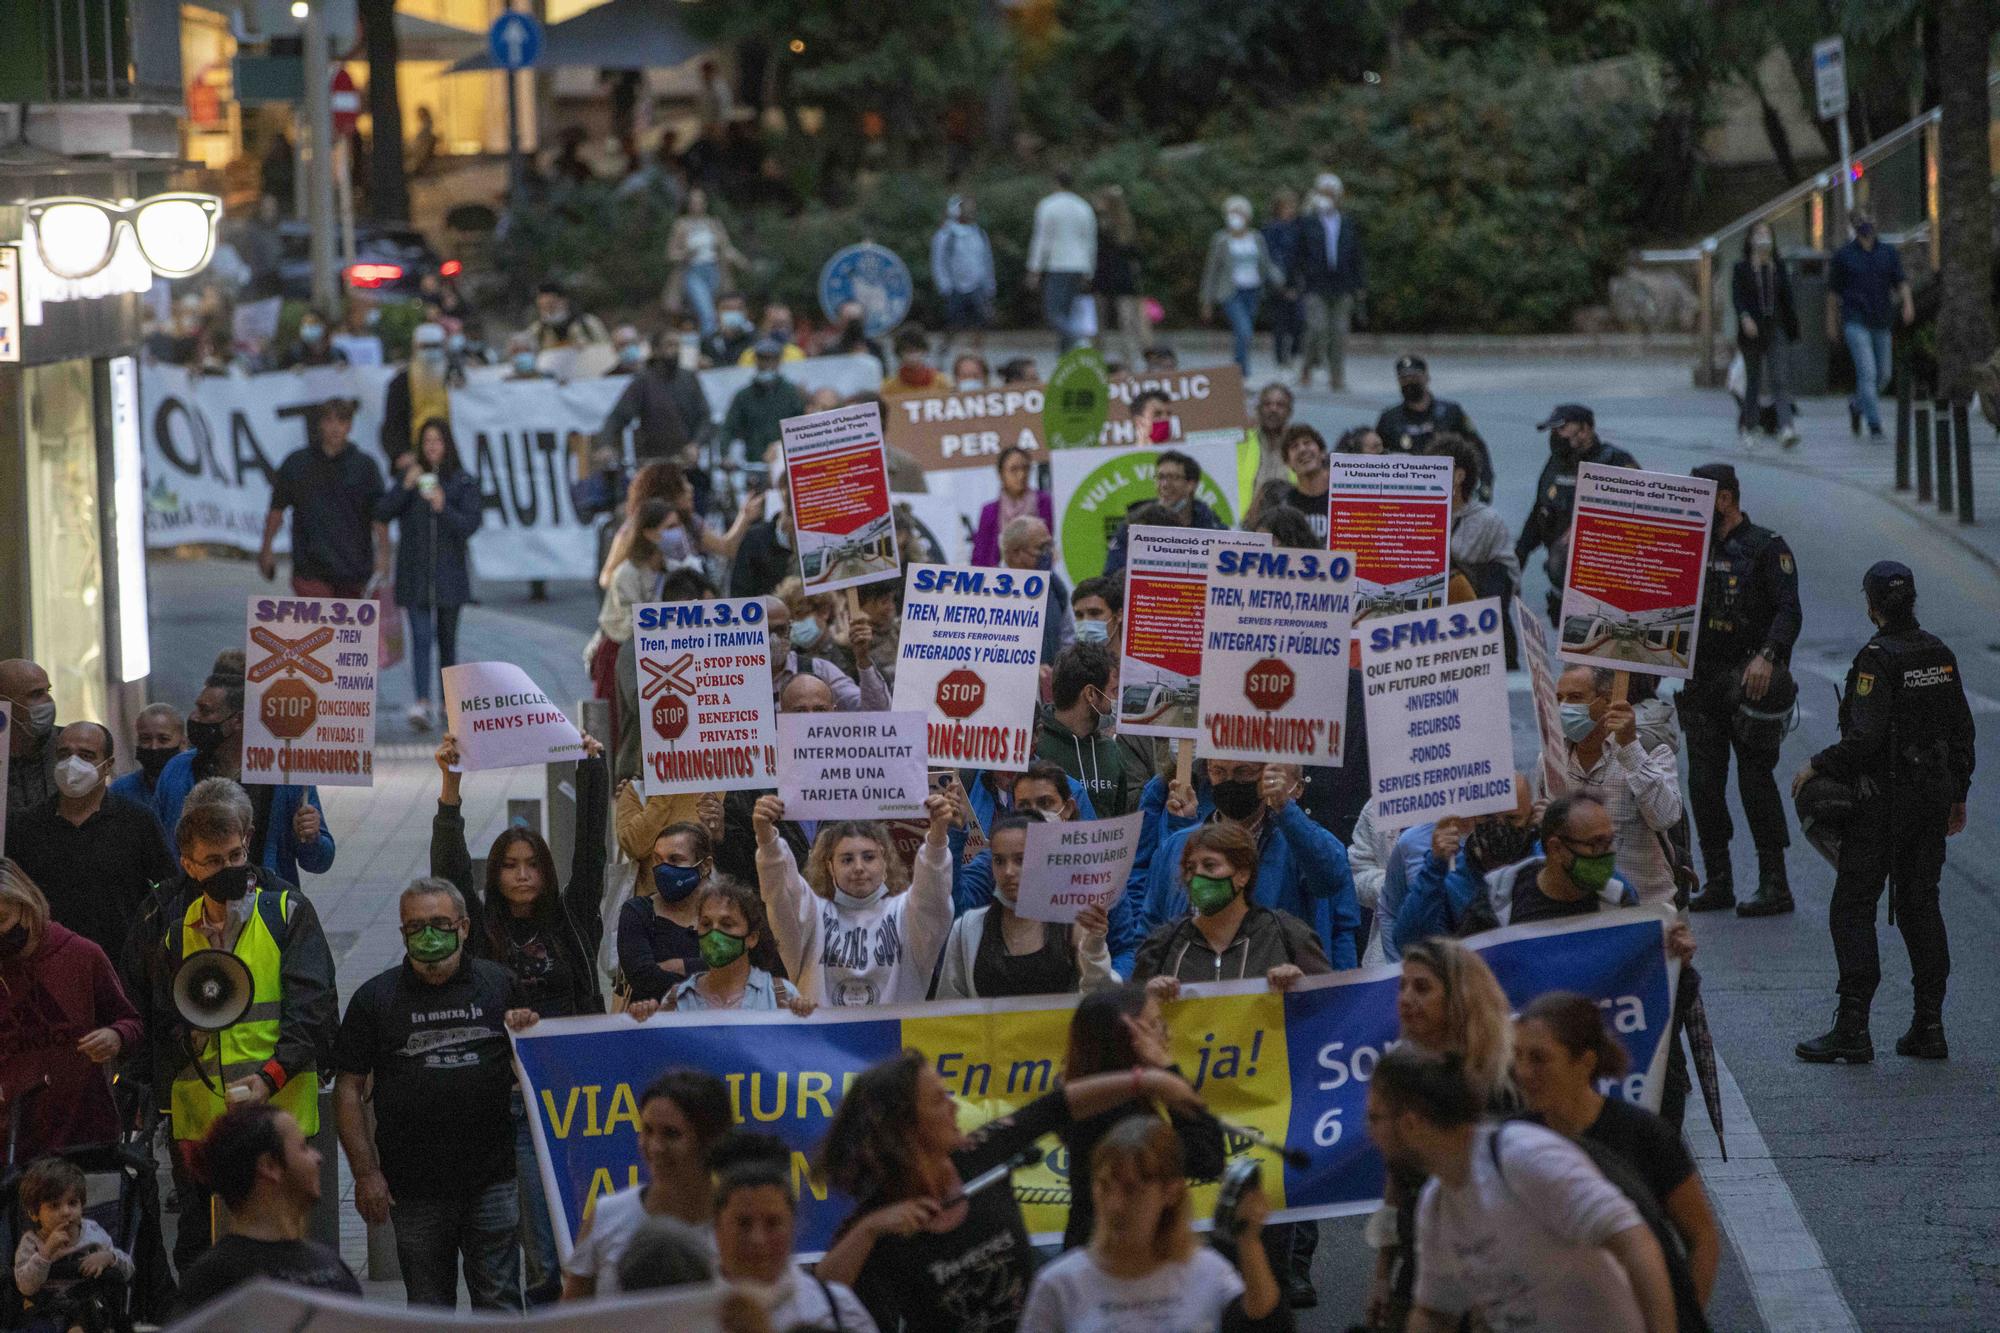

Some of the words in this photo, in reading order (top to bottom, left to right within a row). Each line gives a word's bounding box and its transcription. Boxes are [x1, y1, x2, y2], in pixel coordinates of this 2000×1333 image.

[902, 391, 1045, 425] TRANSPO
[784, 420, 831, 434] Associació
[799, 429, 833, 440] Usuaris
[847, 422, 868, 430] Tren
[941, 431, 1000, 458] PER
[1017, 427, 1040, 451] A
[1080, 471, 1130, 512] VULL
[1582, 472, 1646, 487] Associació
[1648, 482, 1710, 496] d'Usuàries
[1601, 484, 1645, 497] Usuaris
[1667, 494, 1695, 503] Tren
[1134, 534, 1198, 545] Associació
[1153, 546, 1199, 555] Usuaris
[1216, 550, 1350, 582] SFM.3.0
[914, 569, 1044, 598] SFM.3.0
[1210, 587, 1245, 610] TREN,
[255, 600, 376, 626] SFM.3.0
[638, 602, 764, 628] SFM.3.0
[907, 603, 940, 626] TREN,
[1238, 616, 1272, 626] SERVEIS
[1274, 618, 1328, 629] FERROVIARIS
[932, 630, 966, 639] SERVEIS
[967, 632, 1020, 642] FERROVIARIS
[1370, 608, 1498, 652] SFM.3.0
[640, 638, 668, 653] Tren,
[672, 636, 704, 650] metro
[708, 634, 711, 647] i
[714, 631, 764, 647] TRAMVIA
[1208, 632, 1277, 652] INTEGRATS
[1280, 634, 1285, 653] i
[1287, 632, 1341, 656] PÚBLICS
[704, 656, 733, 669] STOP
[736, 655, 766, 667] FONS
[902, 644, 971, 661] INTEGRADOS
[974, 647, 983, 662] Y
[982, 644, 1036, 664] PÚBLICOS
[1366, 662, 1392, 678] QUE
[1395, 657, 1413, 672] NO
[1416, 655, 1431, 668] TE
[1434, 646, 1478, 665] PRIVEN
[1482, 642, 1499, 656] DE
[696, 673, 744, 687] PÚBLICS
[1368, 683, 1385, 696] UN
[1389, 673, 1437, 693] FUTURO
[1440, 664, 1490, 683] MEJOR!!
[1904, 666, 1944, 680] POLICIA
[1904, 675, 1952, 688] NACIONAL
[941, 684, 981, 702] STOP
[1250, 674, 1291, 693] STOP
[266, 697, 311, 717] STOP
[318, 701, 370, 717] CONCESIONES
[461, 696, 490, 713] MÉS
[495, 693, 548, 708] BICICLE
[698, 694, 720, 706] PER
[722, 693, 731, 704] A
[473, 715, 523, 732] MENYS
[527, 712, 566, 725] FUMS
[656, 706, 684, 725] STOP
[698, 710, 759, 724] BENEFICIS
[317, 727, 355, 743] PRIVADAS
[700, 730, 748, 742] PRIVATS
[807, 726, 877, 738] AFAVORIR
[882, 725, 897, 737] LA
[793, 746, 912, 759] INTERMODALITAT
[928, 723, 1010, 762] RINGUITOS
[1013, 728, 1027, 764] !!
[246, 747, 275, 772] STOP
[278, 747, 360, 774] CHIRINGUITOS
[764, 745, 776, 776] !!
[821, 768, 851, 780] AMB
[856, 767, 885, 779] UNA
[1379, 772, 1421, 794] SERVEIS
[1424, 760, 1492, 786] FERROVIARIS
[801, 789, 858, 800] TARJETA
[862, 786, 906, 800] ÚNICA
[1379, 790, 1446, 817] INTEGRADOS
[1448, 789, 1456, 804] Y
[1458, 778, 1510, 802] PÚBLICOS
[1061, 831, 1088, 845] MÉS
[1091, 828, 1124, 843] LÍNIES
[1047, 846, 1128, 866] FERROVIÀRIES
[1071, 872, 1112, 885] MENYS
[1050, 888, 1117, 905] AUTOPIST
[412, 1012, 425, 1023] En
[429, 1008, 469, 1020] marxa,
[470, 1003, 483, 1020] ja
[936, 1052, 991, 1098] En
[1195, 1030, 1264, 1092] ja!
[1317, 1042, 1399, 1091] So
[1313, 1108, 1344, 1147] 6
